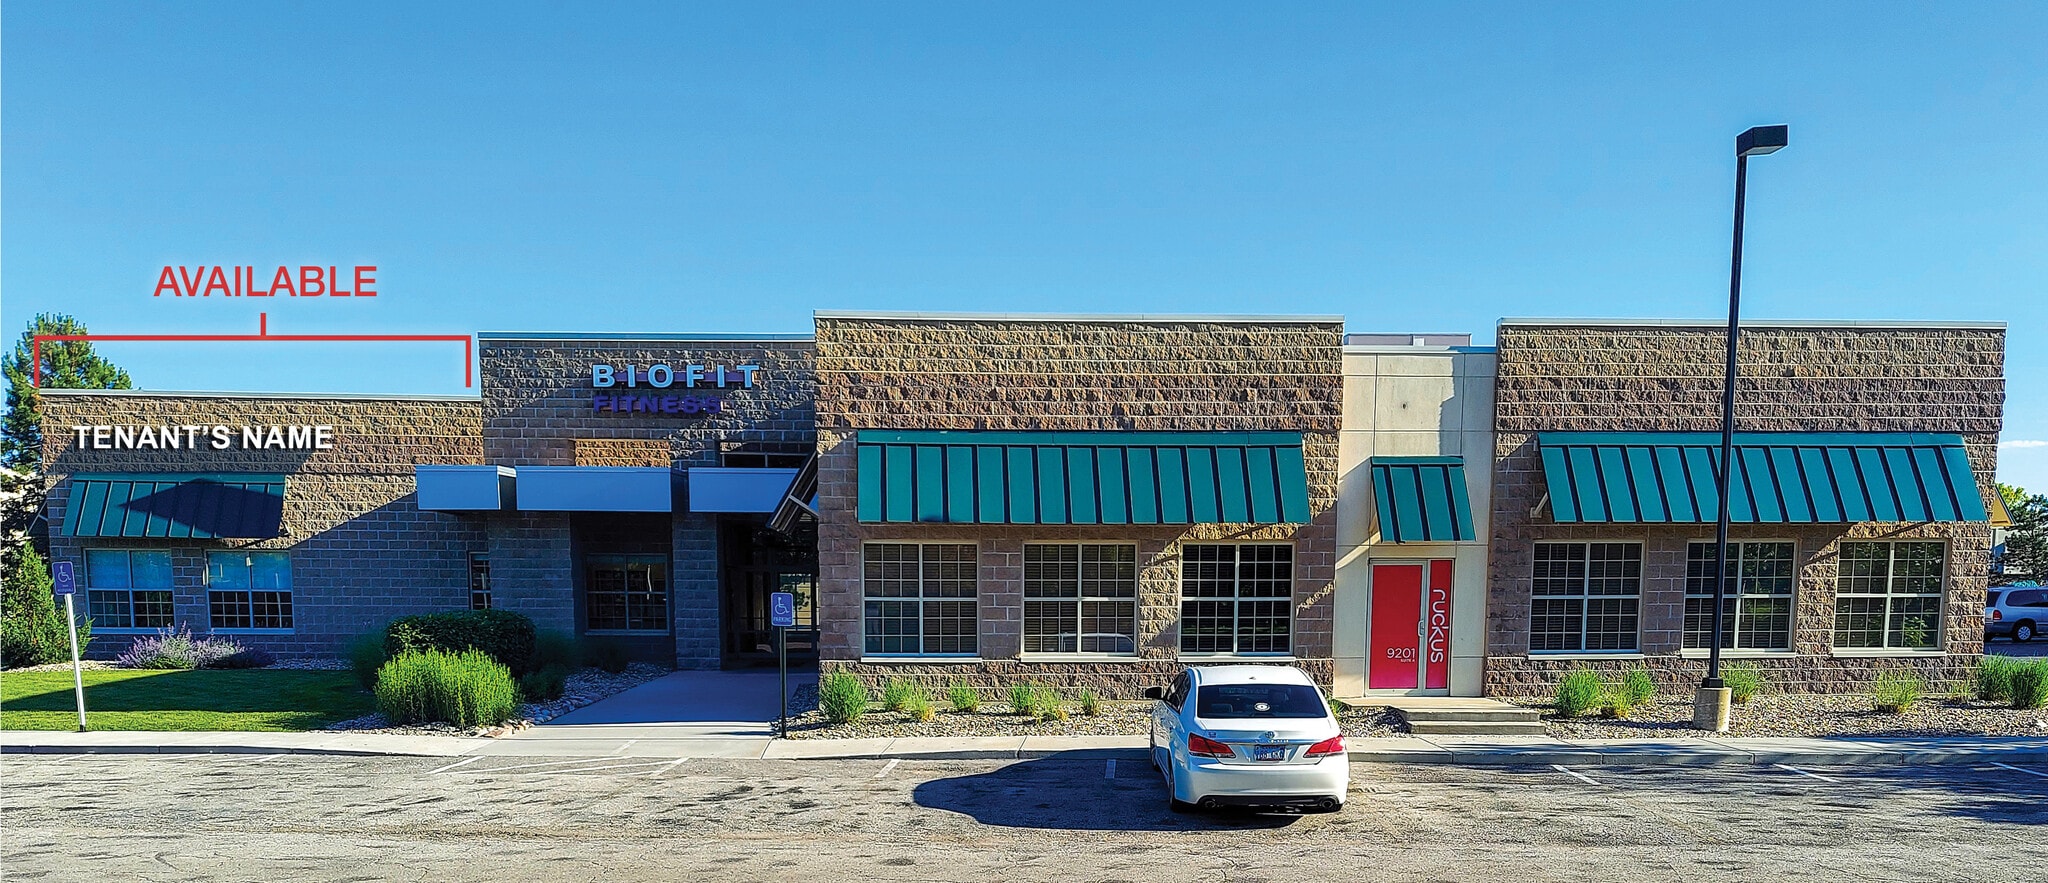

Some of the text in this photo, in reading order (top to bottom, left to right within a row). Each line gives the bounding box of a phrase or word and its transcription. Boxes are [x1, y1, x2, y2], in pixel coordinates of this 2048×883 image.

[592, 364, 759, 388] BIOFIT
[593, 395, 721, 413] FITNESS
[1387, 647, 1416, 659] 9201
